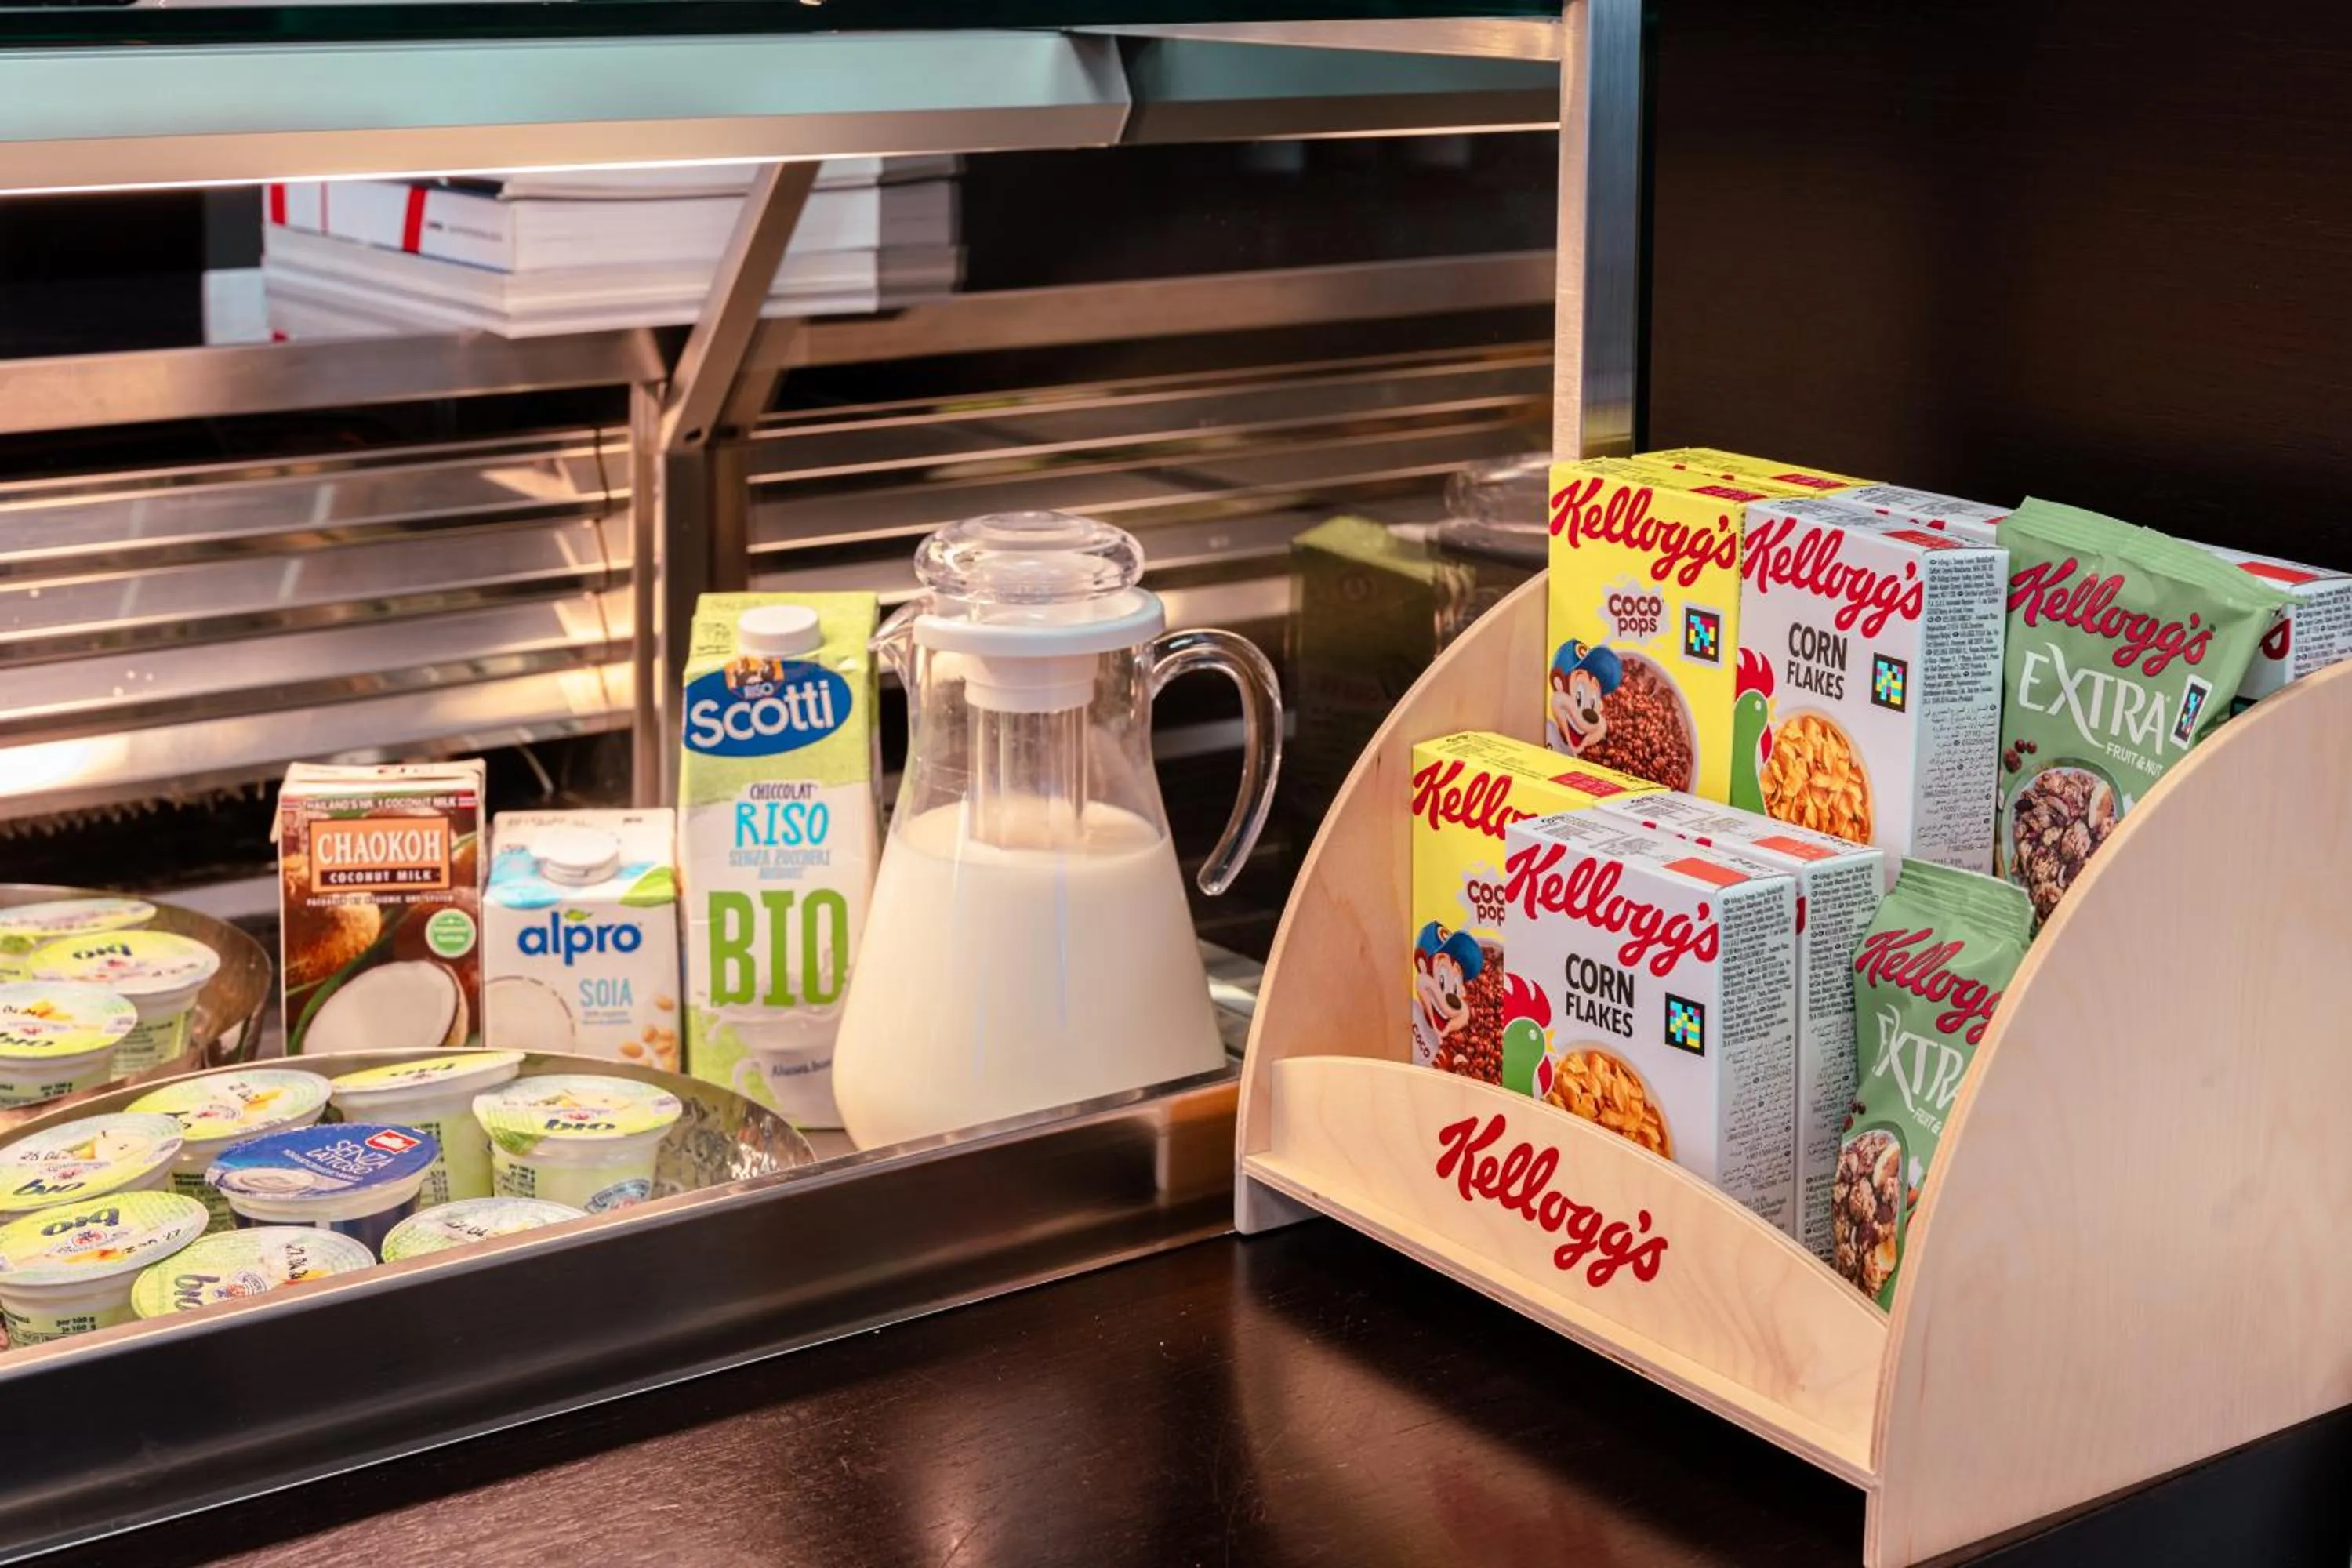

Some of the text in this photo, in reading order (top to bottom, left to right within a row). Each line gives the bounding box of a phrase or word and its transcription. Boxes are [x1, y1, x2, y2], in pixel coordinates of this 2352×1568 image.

[1548, 476, 1737, 587] Kellogg's
[1741, 517, 1924, 639] Kellogg's
[1607, 593, 1662, 618] COCO
[1618, 615, 1657, 639] pops
[2008, 557, 2214, 677] Kellogg's
[1788, 622, 1848, 672] CORN
[1786, 660, 1845, 700] FLAKES
[2019, 642, 2165, 756] EXTRA
[2106, 742, 2139, 767] FRUIT
[2145, 758, 2164, 778] NUT
[433, 797, 457, 808] MILK
[735, 801, 830, 848] RISO
[317, 829, 442, 864] CHAOKOH
[328, 869, 432, 884] COCONUT MILK
[1467, 880, 1505, 905] COC
[1477, 904, 1505, 926] pop
[1505, 843, 1719, 978] Kellogg's
[517, 910, 643, 967] alpro
[708, 887, 849, 1008] BIO
[579, 978, 633, 1007] SOIA
[1565, 952, 1635, 1009] CORN
[1566, 990, 1634, 1039] FLAKES
[1871, 1003, 1965, 1112] EXTR
[1436, 1113, 1669, 1287] Kellogg's
